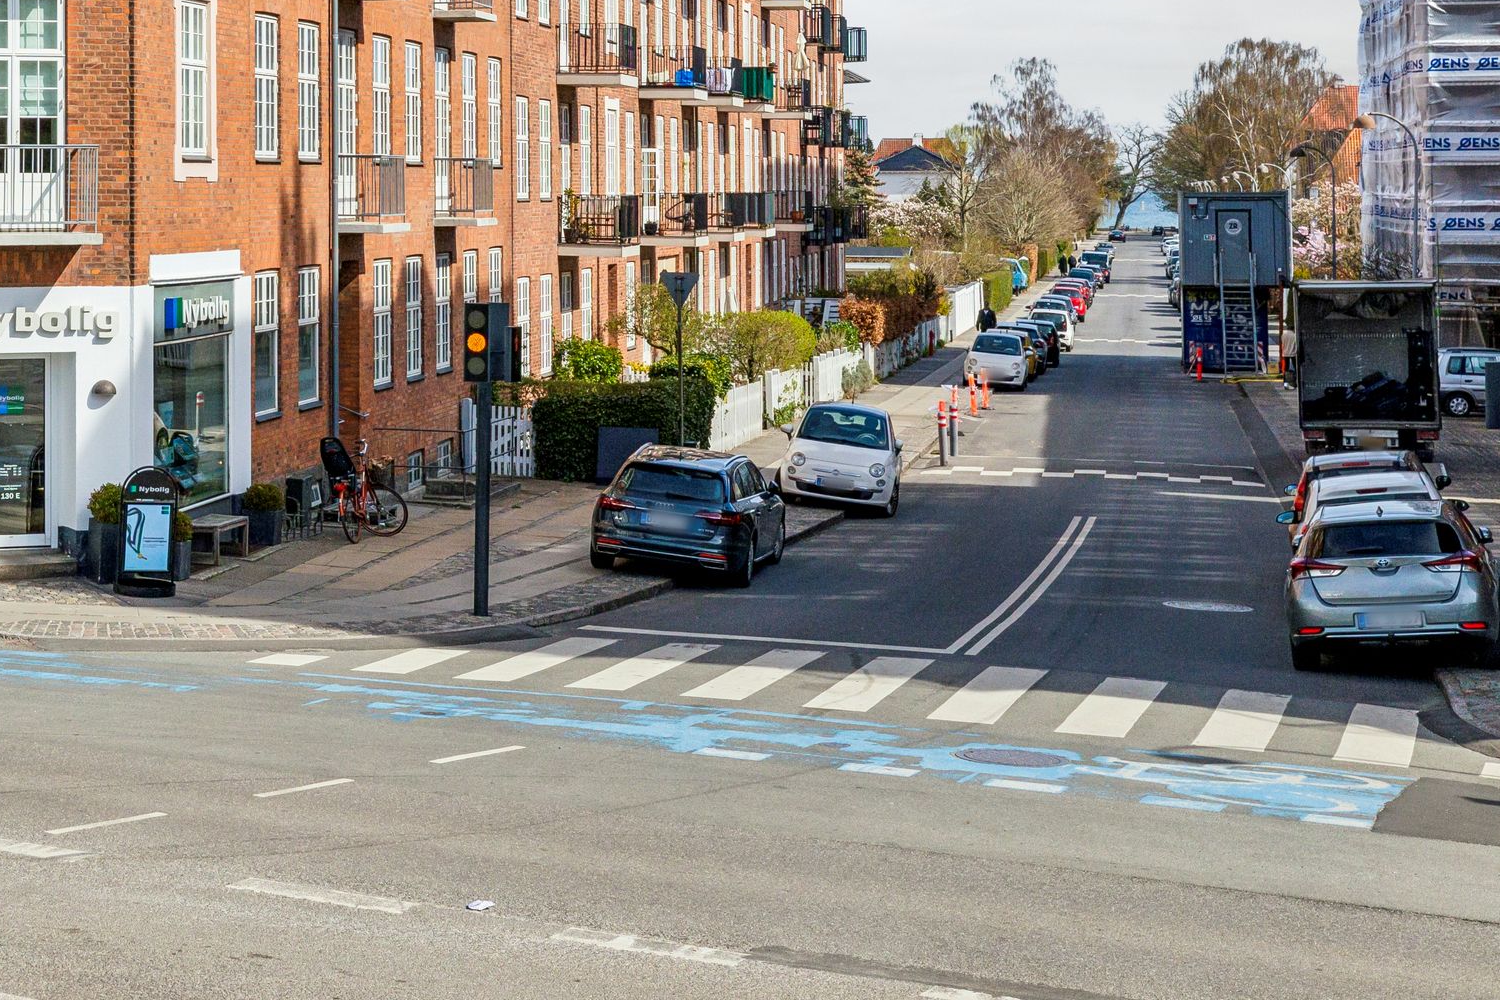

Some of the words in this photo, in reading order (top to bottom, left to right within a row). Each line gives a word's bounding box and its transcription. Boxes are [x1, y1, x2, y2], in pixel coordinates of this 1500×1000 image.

[1427, 57, 1469, 71] ØENS
[1423, 137, 1451, 151] ENS
[1456, 137, 1499, 151] ØENS
[1442, 217, 1485, 231] ØENS
[183, 295, 230, 328] Nybolig
[1, 492, 14, 500] 130
[138, 486, 170, 494] Nybolig
